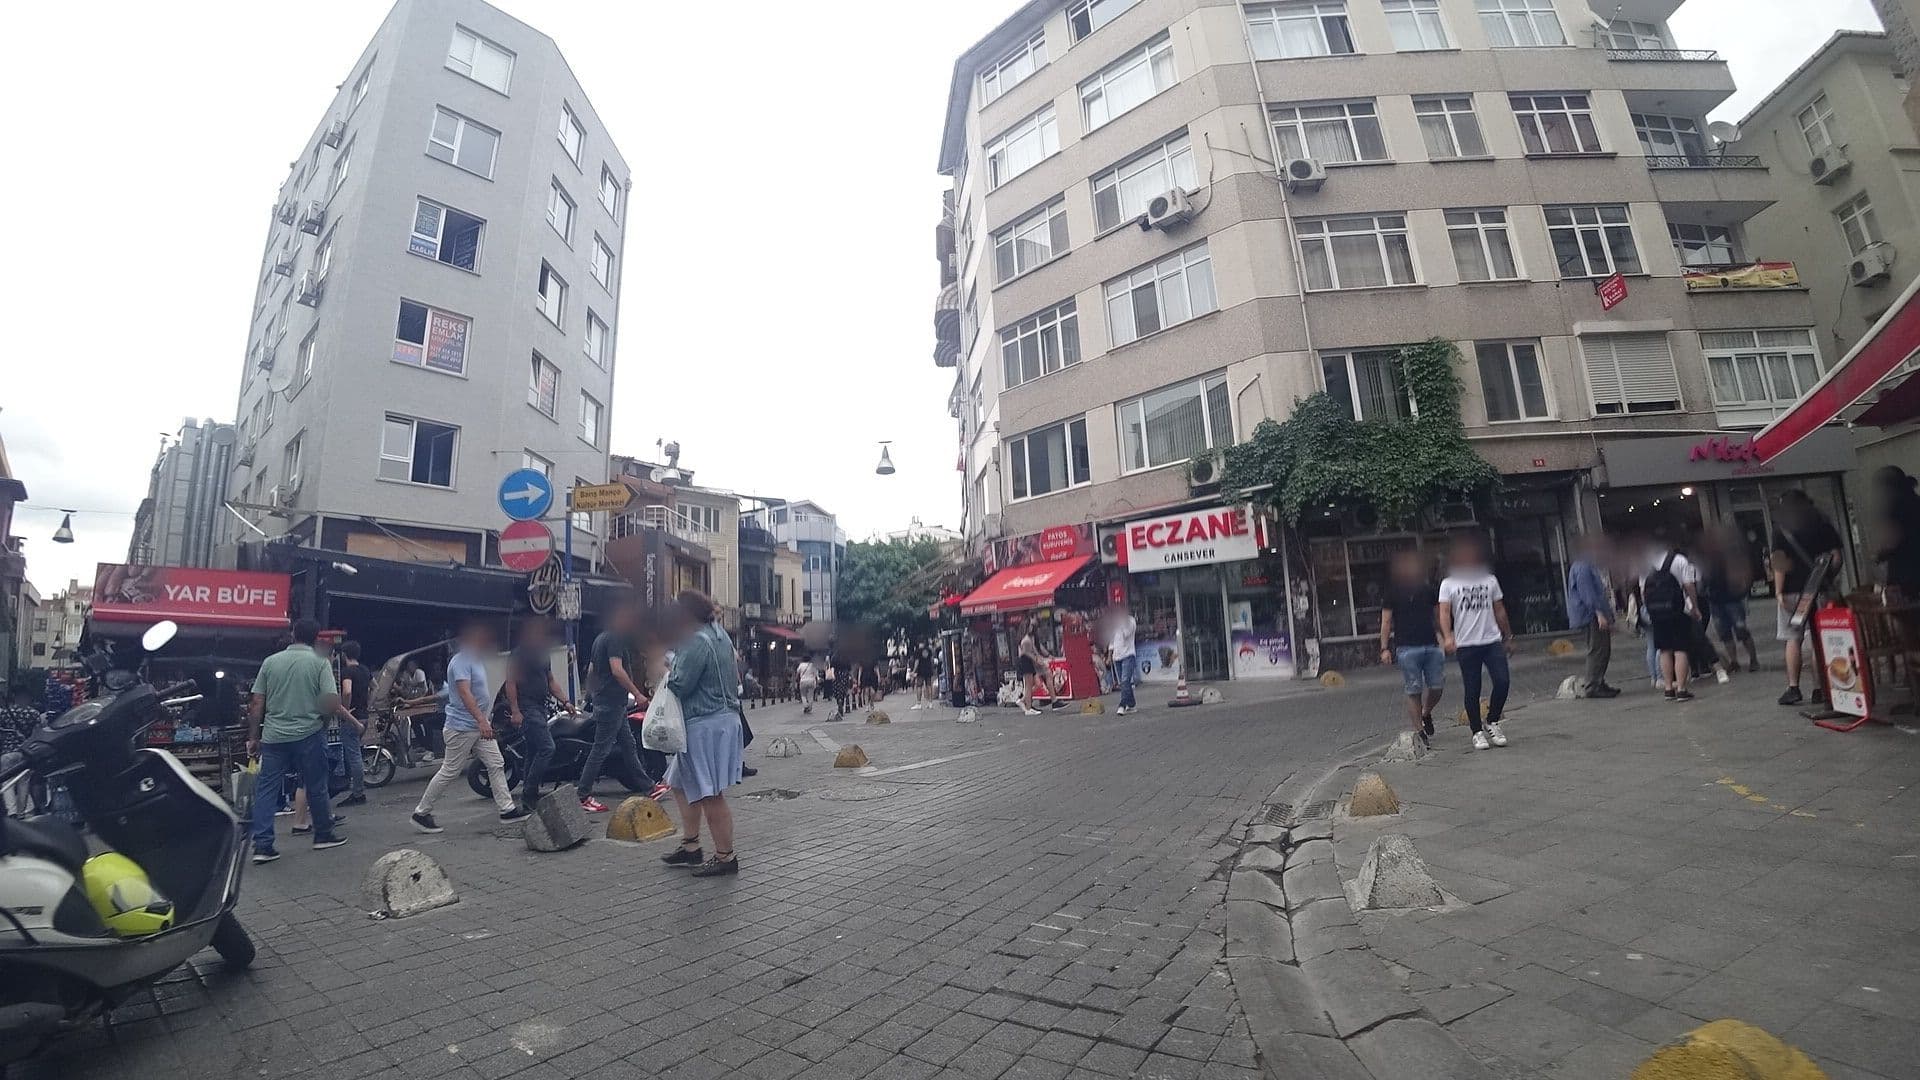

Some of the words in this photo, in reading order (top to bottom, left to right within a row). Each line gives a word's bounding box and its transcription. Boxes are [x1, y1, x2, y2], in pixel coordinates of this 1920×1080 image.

[432, 316, 465, 333] REKS
[1131, 508, 1249, 550] ECZANE
[1164, 548, 1216, 564] CANSEVER
[164, 584, 210, 602] YAR
[217, 584, 277, 606] BÜFE
